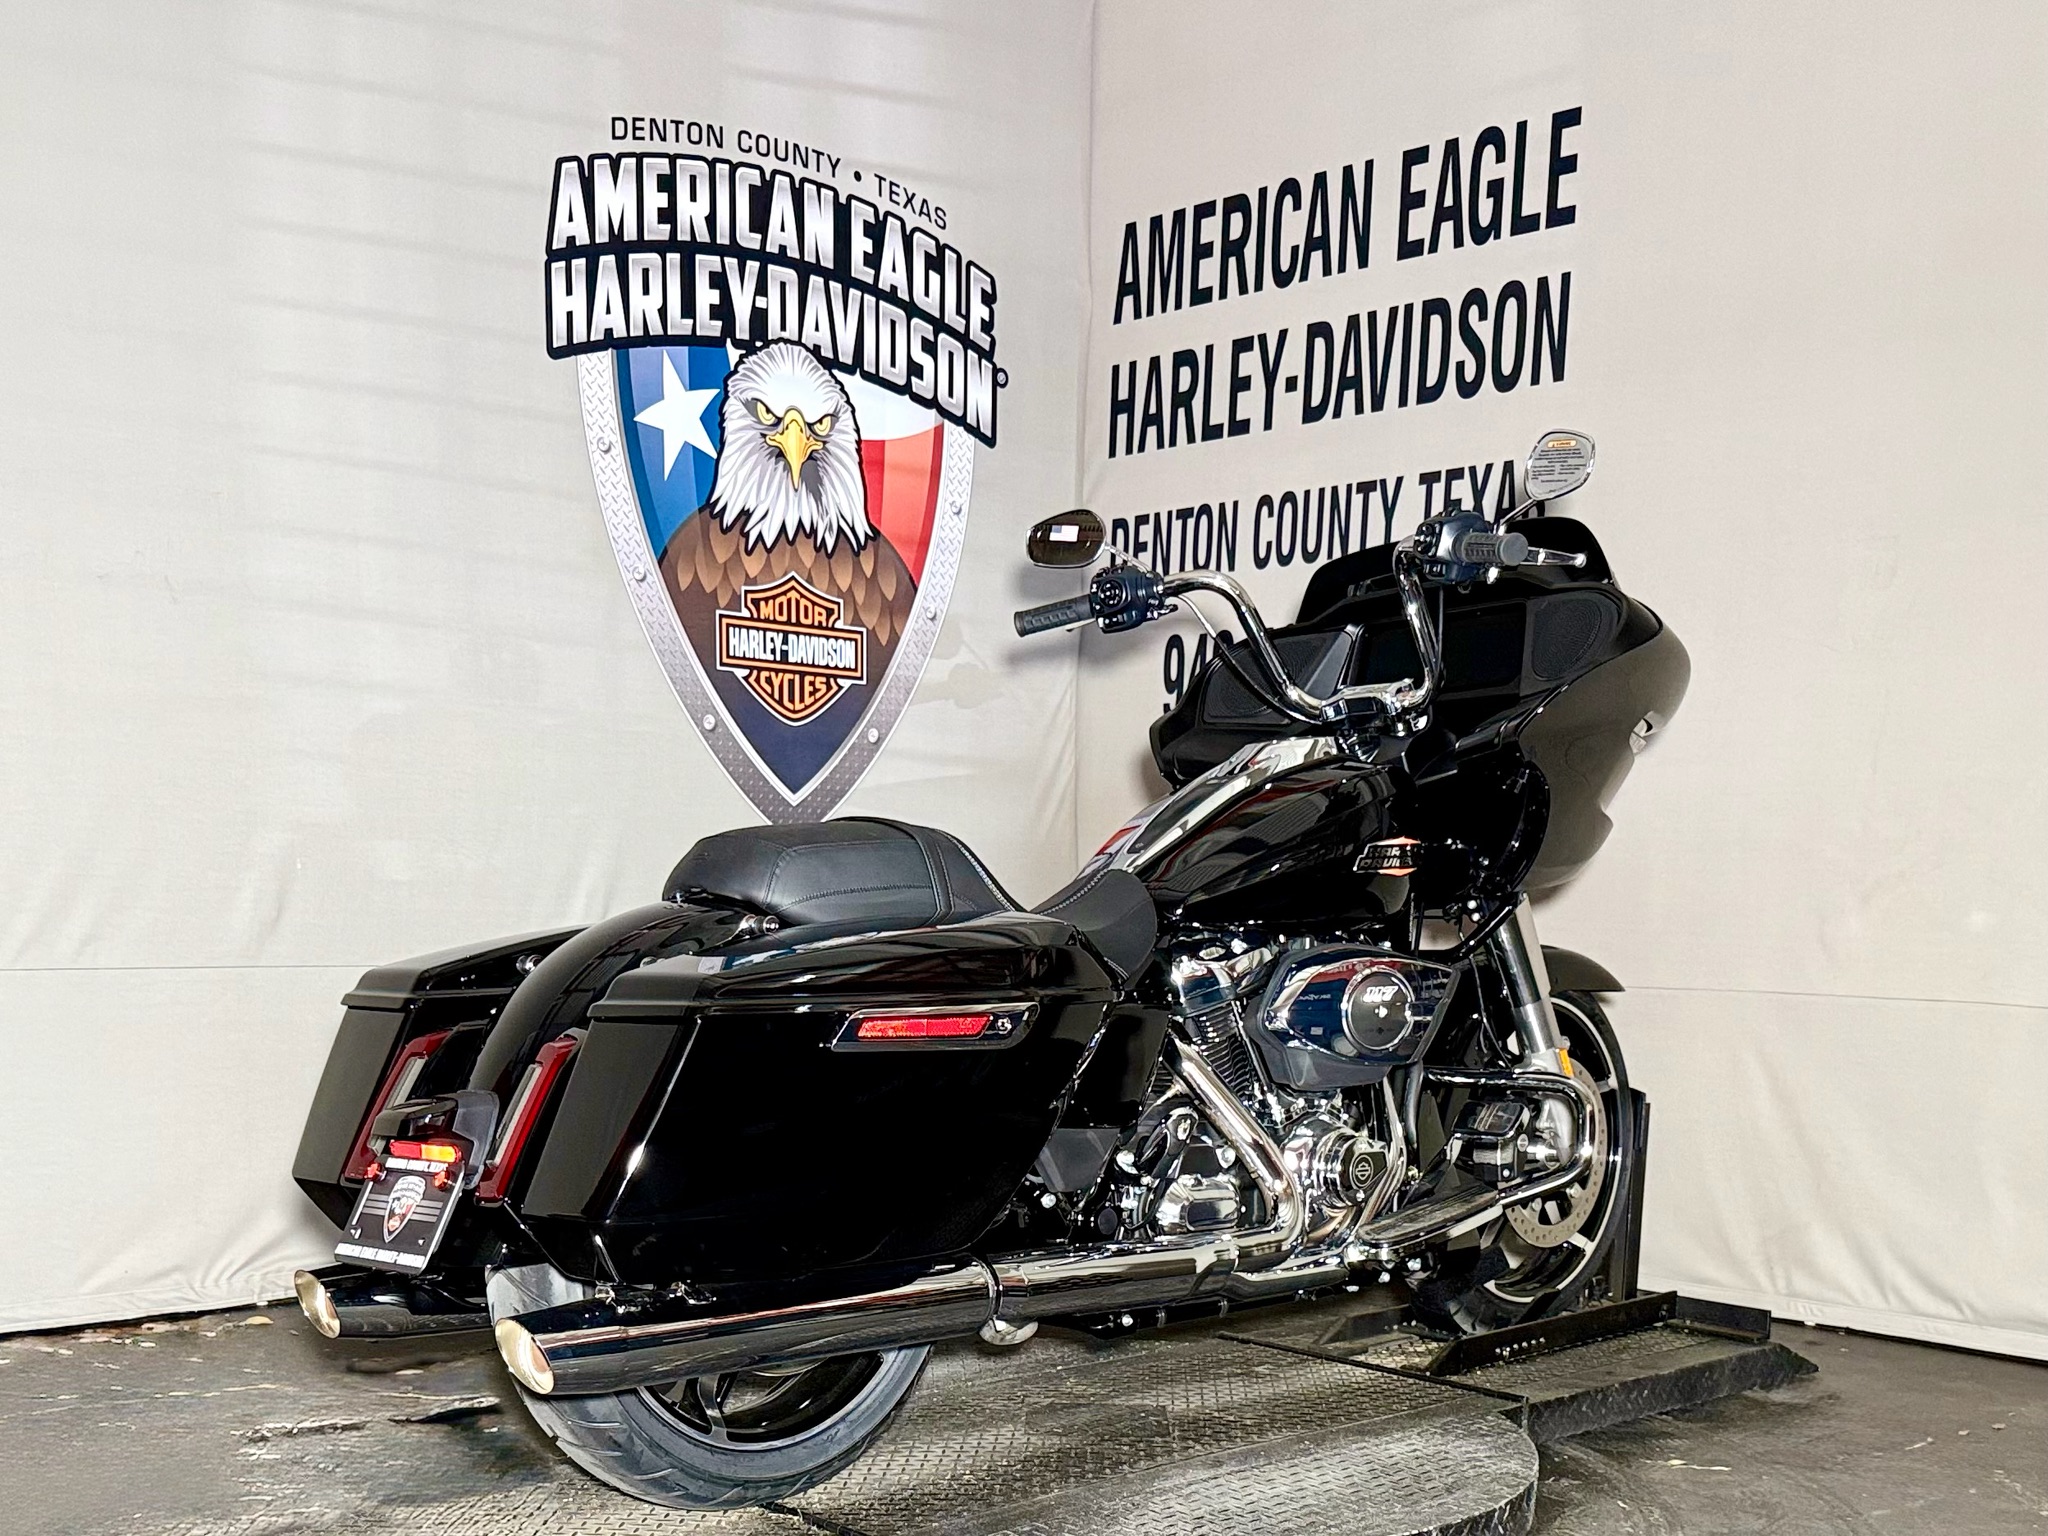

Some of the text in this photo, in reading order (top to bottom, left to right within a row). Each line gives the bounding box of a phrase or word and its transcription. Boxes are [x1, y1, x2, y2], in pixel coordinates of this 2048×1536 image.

[611, 116, 947, 230] DENTON COUNTY TEXAS
[1113, 106, 1582, 325] AMERICAN EAGLE
[551, 156, 996, 348] AMERICAN EAGLE
[551, 252, 996, 437] HARLEY-DAVIDSON
[1108, 271, 1571, 459] HARLEY-DAVIDSON
[1110, 500, 1239, 577] DENTON
[1253, 476, 1404, 570] COUNTY
[1419, 460, 1545, 531] TEXA
[729, 626, 856, 670] HARLEY-DAVIDSON
[760, 589, 827, 627] MOTOR
[760, 670, 827, 711] CYCLES
[1362, 985, 1398, 1003] 117
